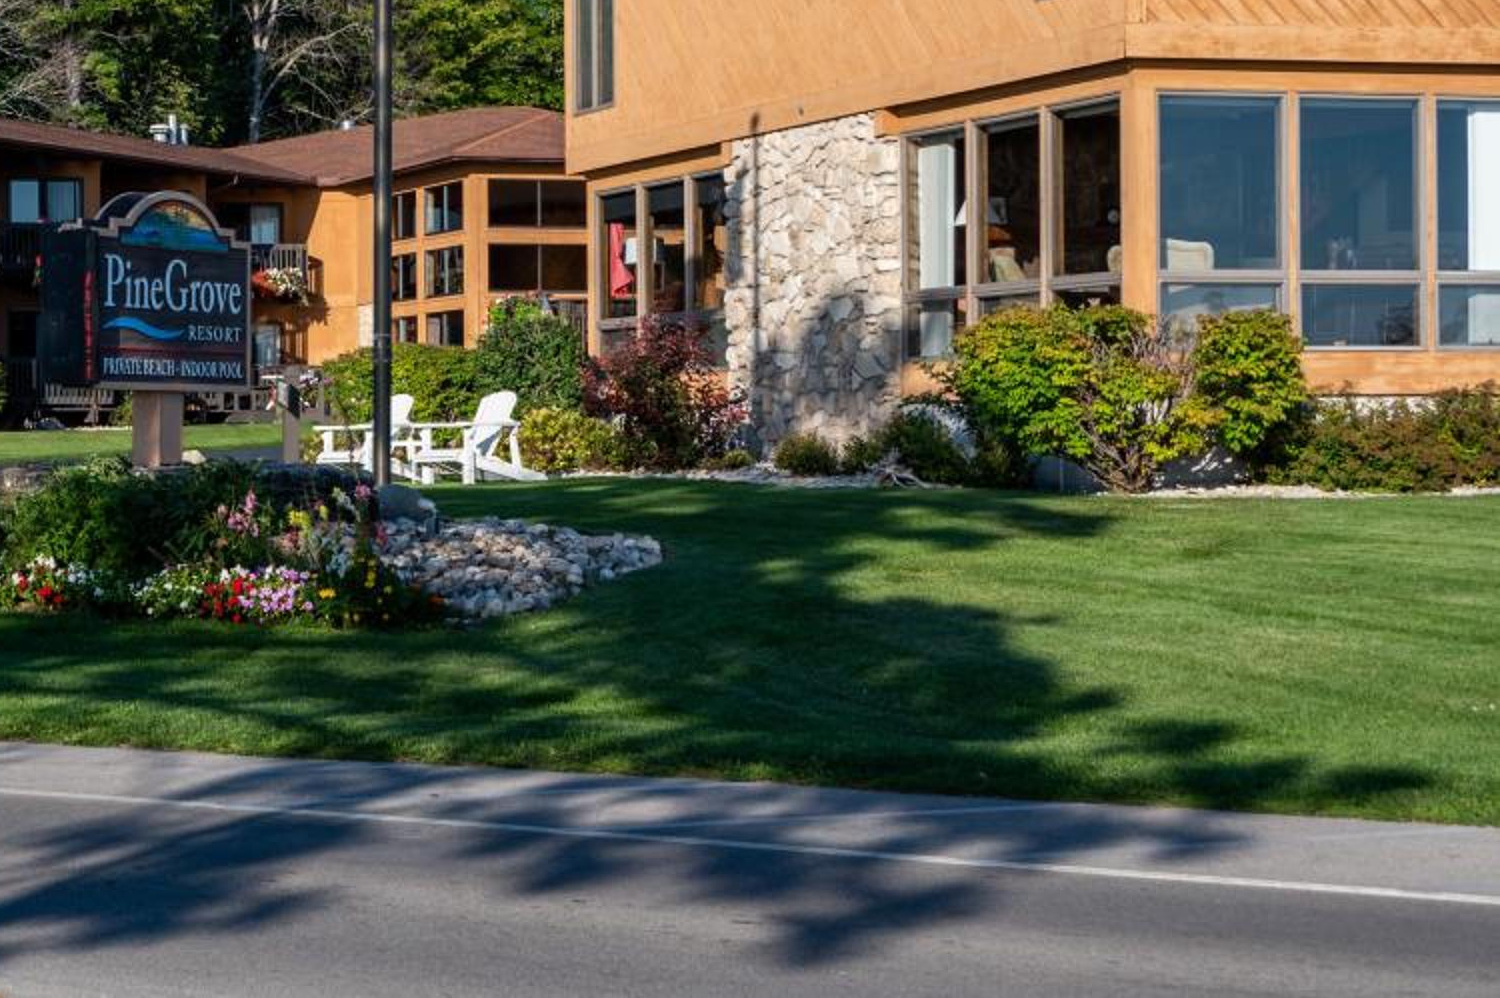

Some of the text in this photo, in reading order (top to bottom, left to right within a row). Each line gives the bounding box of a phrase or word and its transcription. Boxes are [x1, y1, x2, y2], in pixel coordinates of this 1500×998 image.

[188, 325, 241, 342] RESORT
[103, 357, 142, 375] PRIVATE
[144, 358, 175, 377] BEACH
[181, 360, 217, 377] INDOOR
[219, 362, 243, 379] POOL
